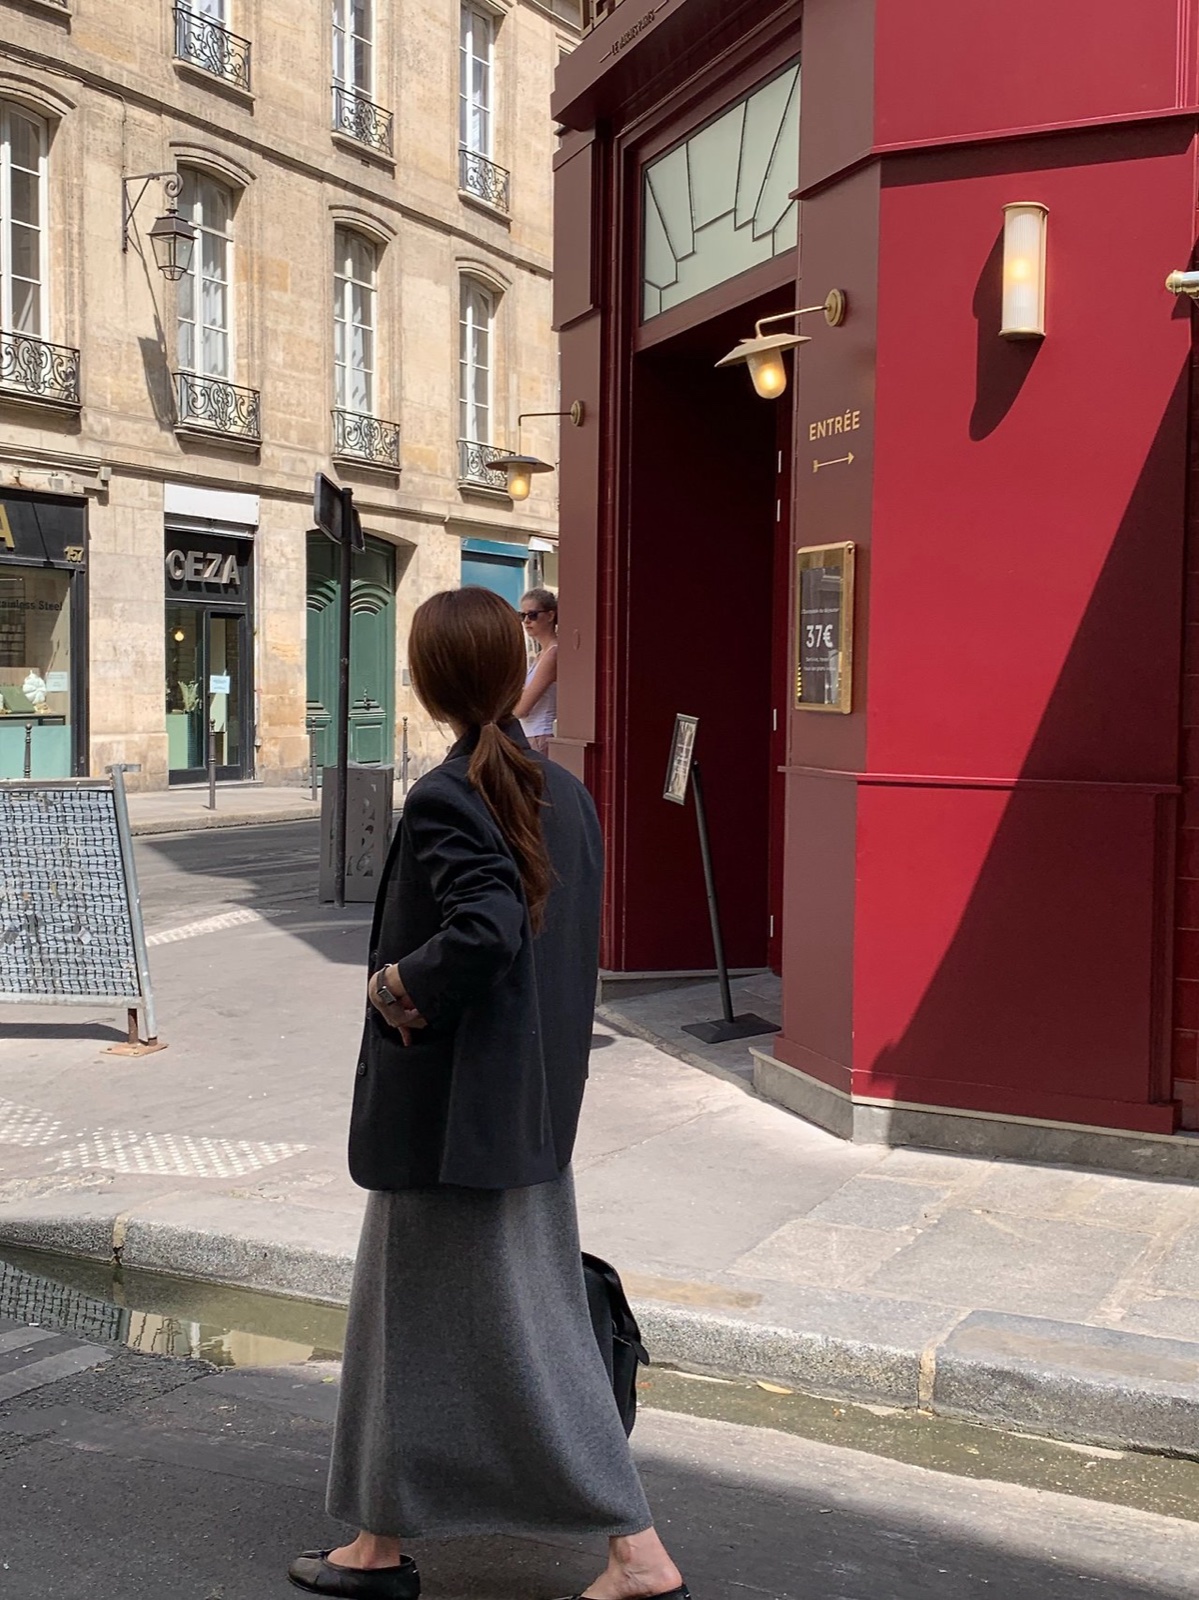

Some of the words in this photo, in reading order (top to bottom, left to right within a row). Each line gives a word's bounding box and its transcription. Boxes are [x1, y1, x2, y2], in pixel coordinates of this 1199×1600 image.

[809, 409, 860, 441] ENTRÉE
[64, 545, 84, 563] 157
[165, 549, 240, 585] CEZA
[0, 599, 35, 610] ainless
[38, 600, 63, 611] Steel
[806, 624, 834, 648] 37€
